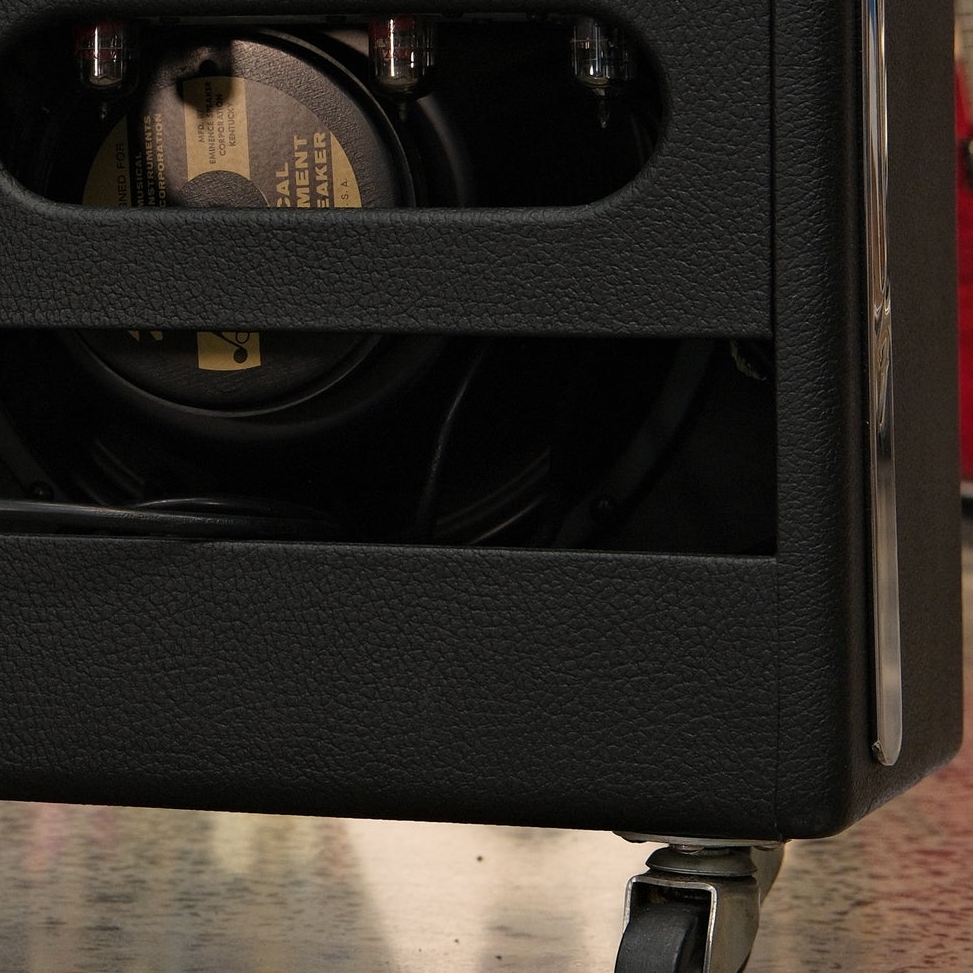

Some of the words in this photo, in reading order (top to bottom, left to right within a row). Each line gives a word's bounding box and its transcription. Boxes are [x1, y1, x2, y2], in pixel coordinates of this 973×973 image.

[207, 121, 216, 164] EMINENCE
[214, 93, 227, 156] CORPORATION
[227, 103, 237, 146] KENTUCKY
[115, 142, 125, 169] FOR
[155, 113, 167, 207] CORPORATION
[293, 135, 310, 207] MENT
